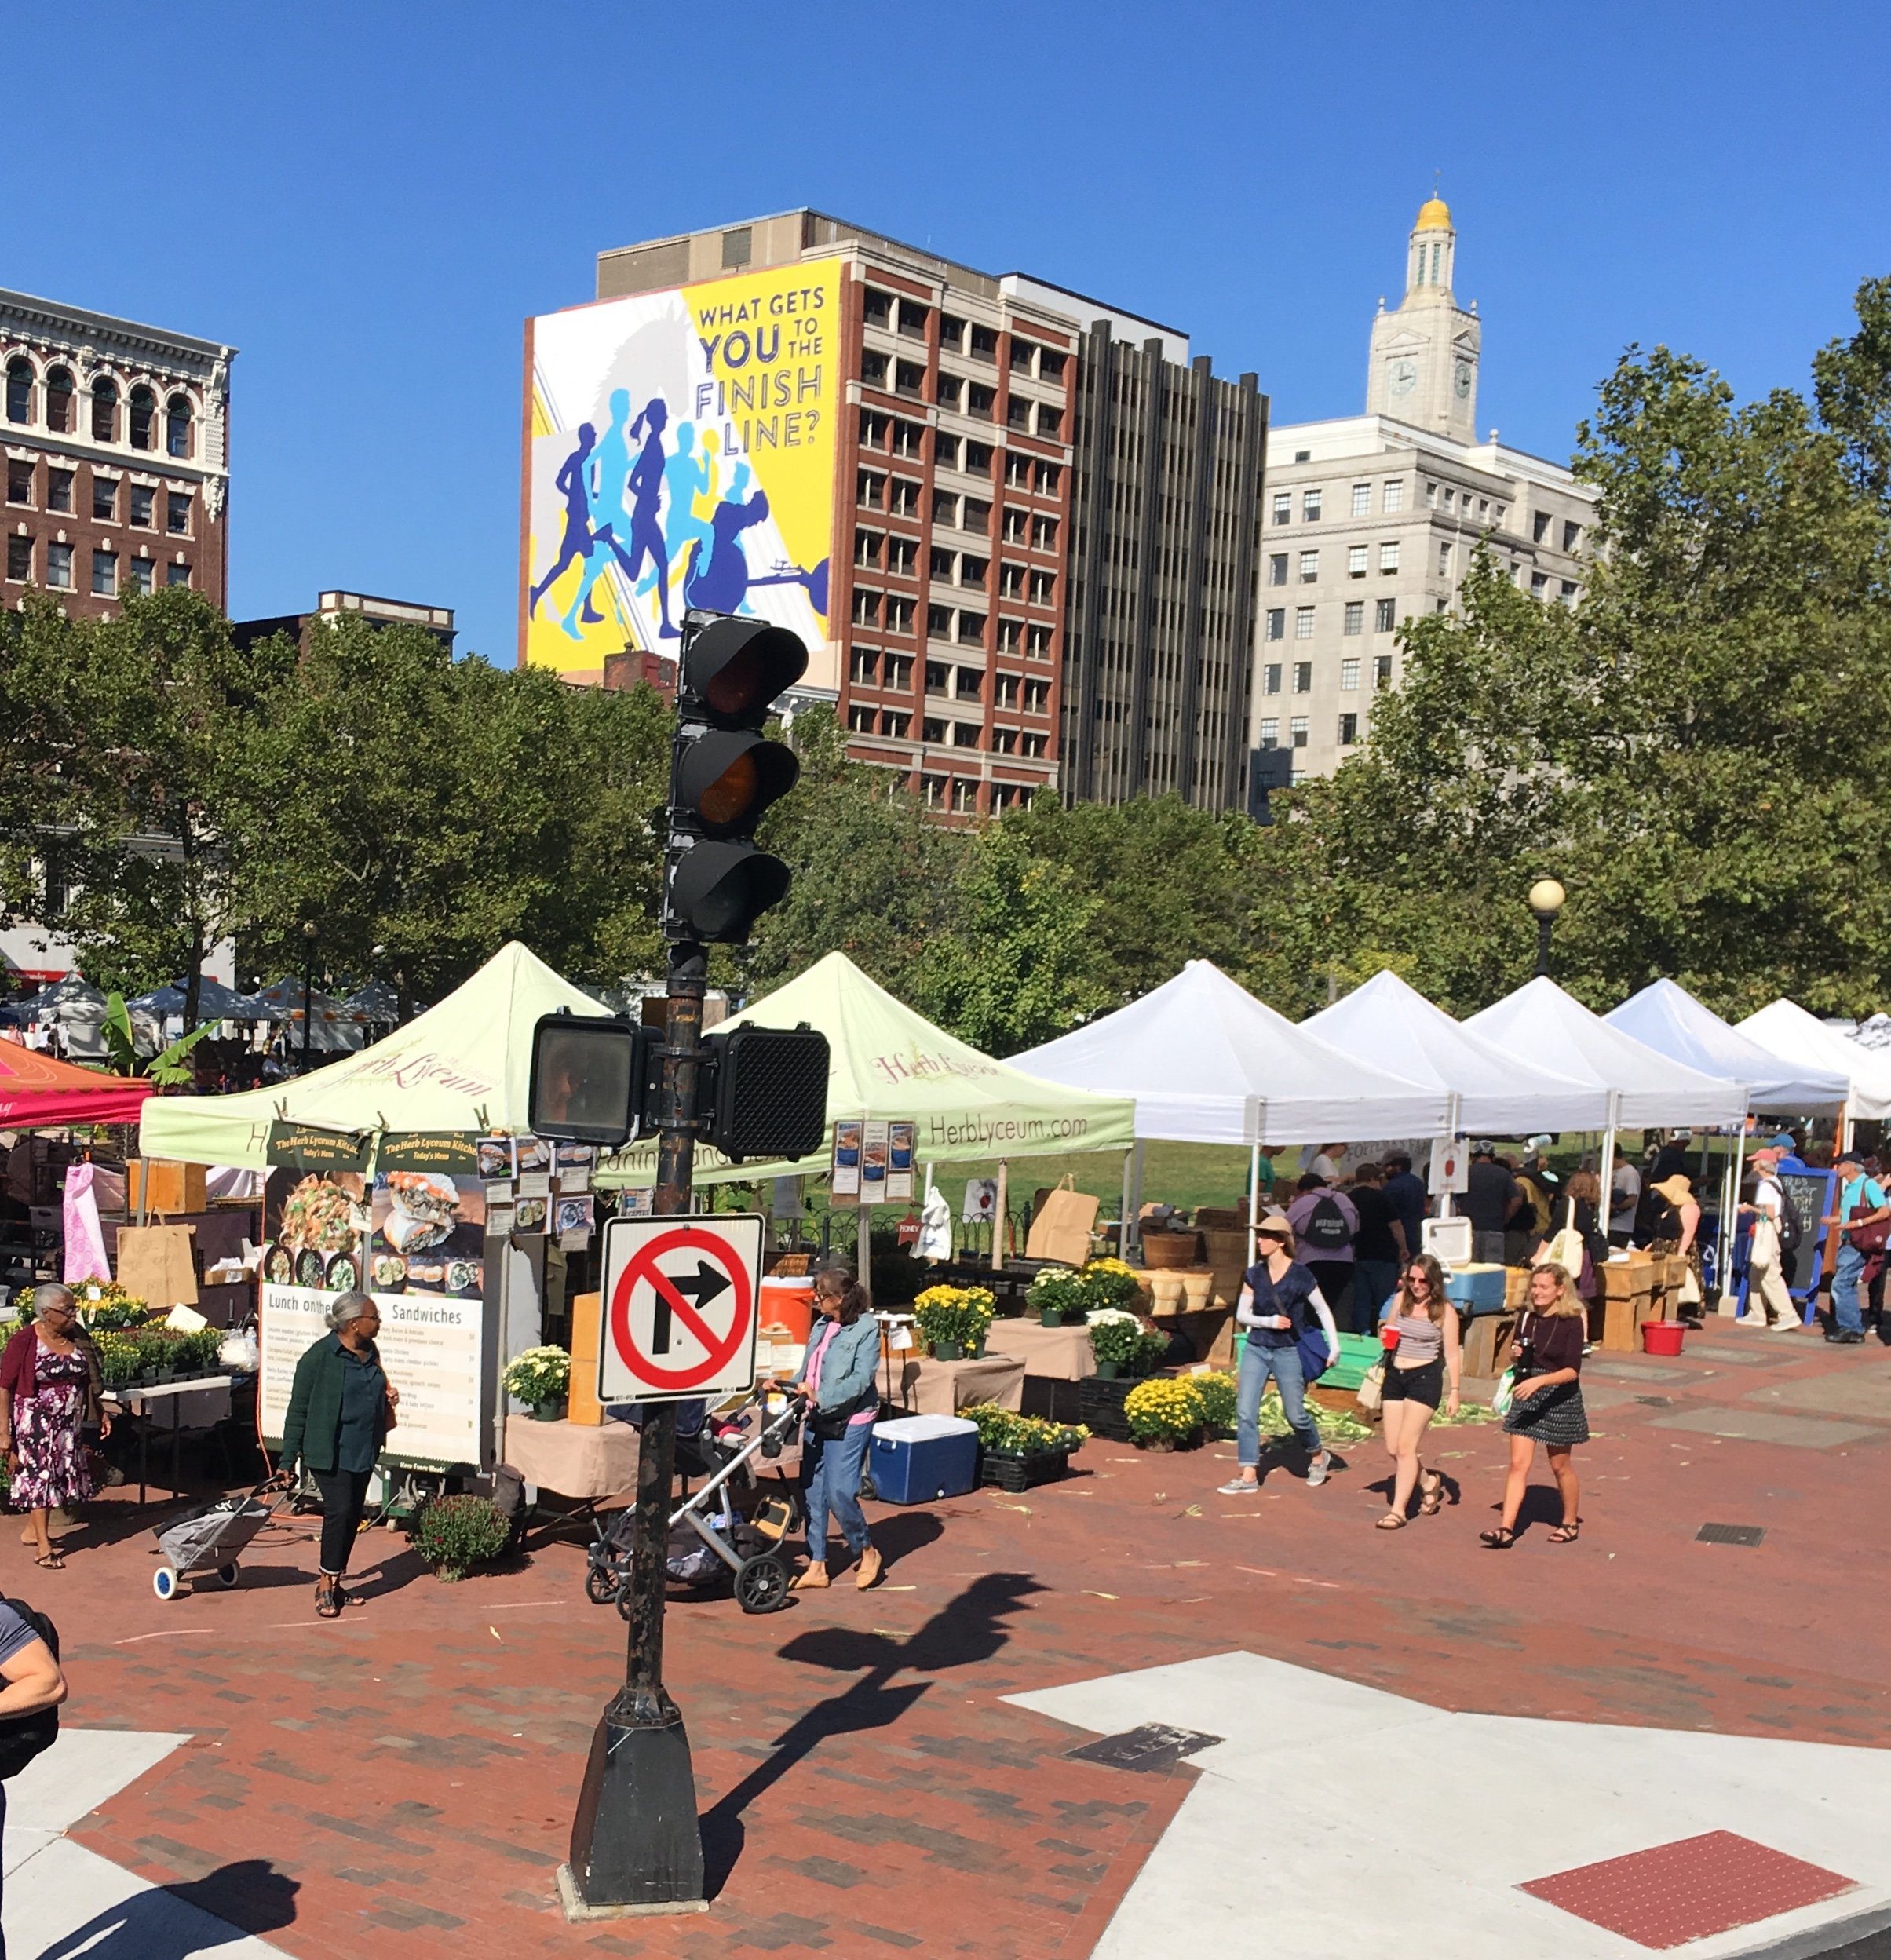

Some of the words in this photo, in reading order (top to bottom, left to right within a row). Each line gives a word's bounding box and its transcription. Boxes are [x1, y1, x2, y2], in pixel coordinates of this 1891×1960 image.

[699, 297, 761, 330] WHAT
[769, 287, 825, 316] GETS
[794, 317, 818, 338] TO
[699, 323, 780, 374] YOU
[788, 337, 823, 359] THE
[696, 364, 822, 419] FINISH
[724, 409, 820, 456] LINE?
[870, 1052, 940, 1084] Herb
[930, 1113, 1088, 1148] HerbLyceum.com
[276, 1138, 290, 1151] The
[290, 1136, 308, 1147] Herb
[309, 1134, 336, 1148] Lyceum
[385, 1144, 402, 1155] The
[403, 1140, 420, 1152] Herb
[421, 1138, 451, 1152] Lyceum
[451, 1141, 478, 1157] Kitche
[413, 1151, 433, 1162] Today's
[433, 1152, 450, 1161] Menu
[899, 1224, 920, 1233] HONEY
[269, 1293, 298, 1311] Lunch
[392, 1304, 462, 1325] Sandwiches
